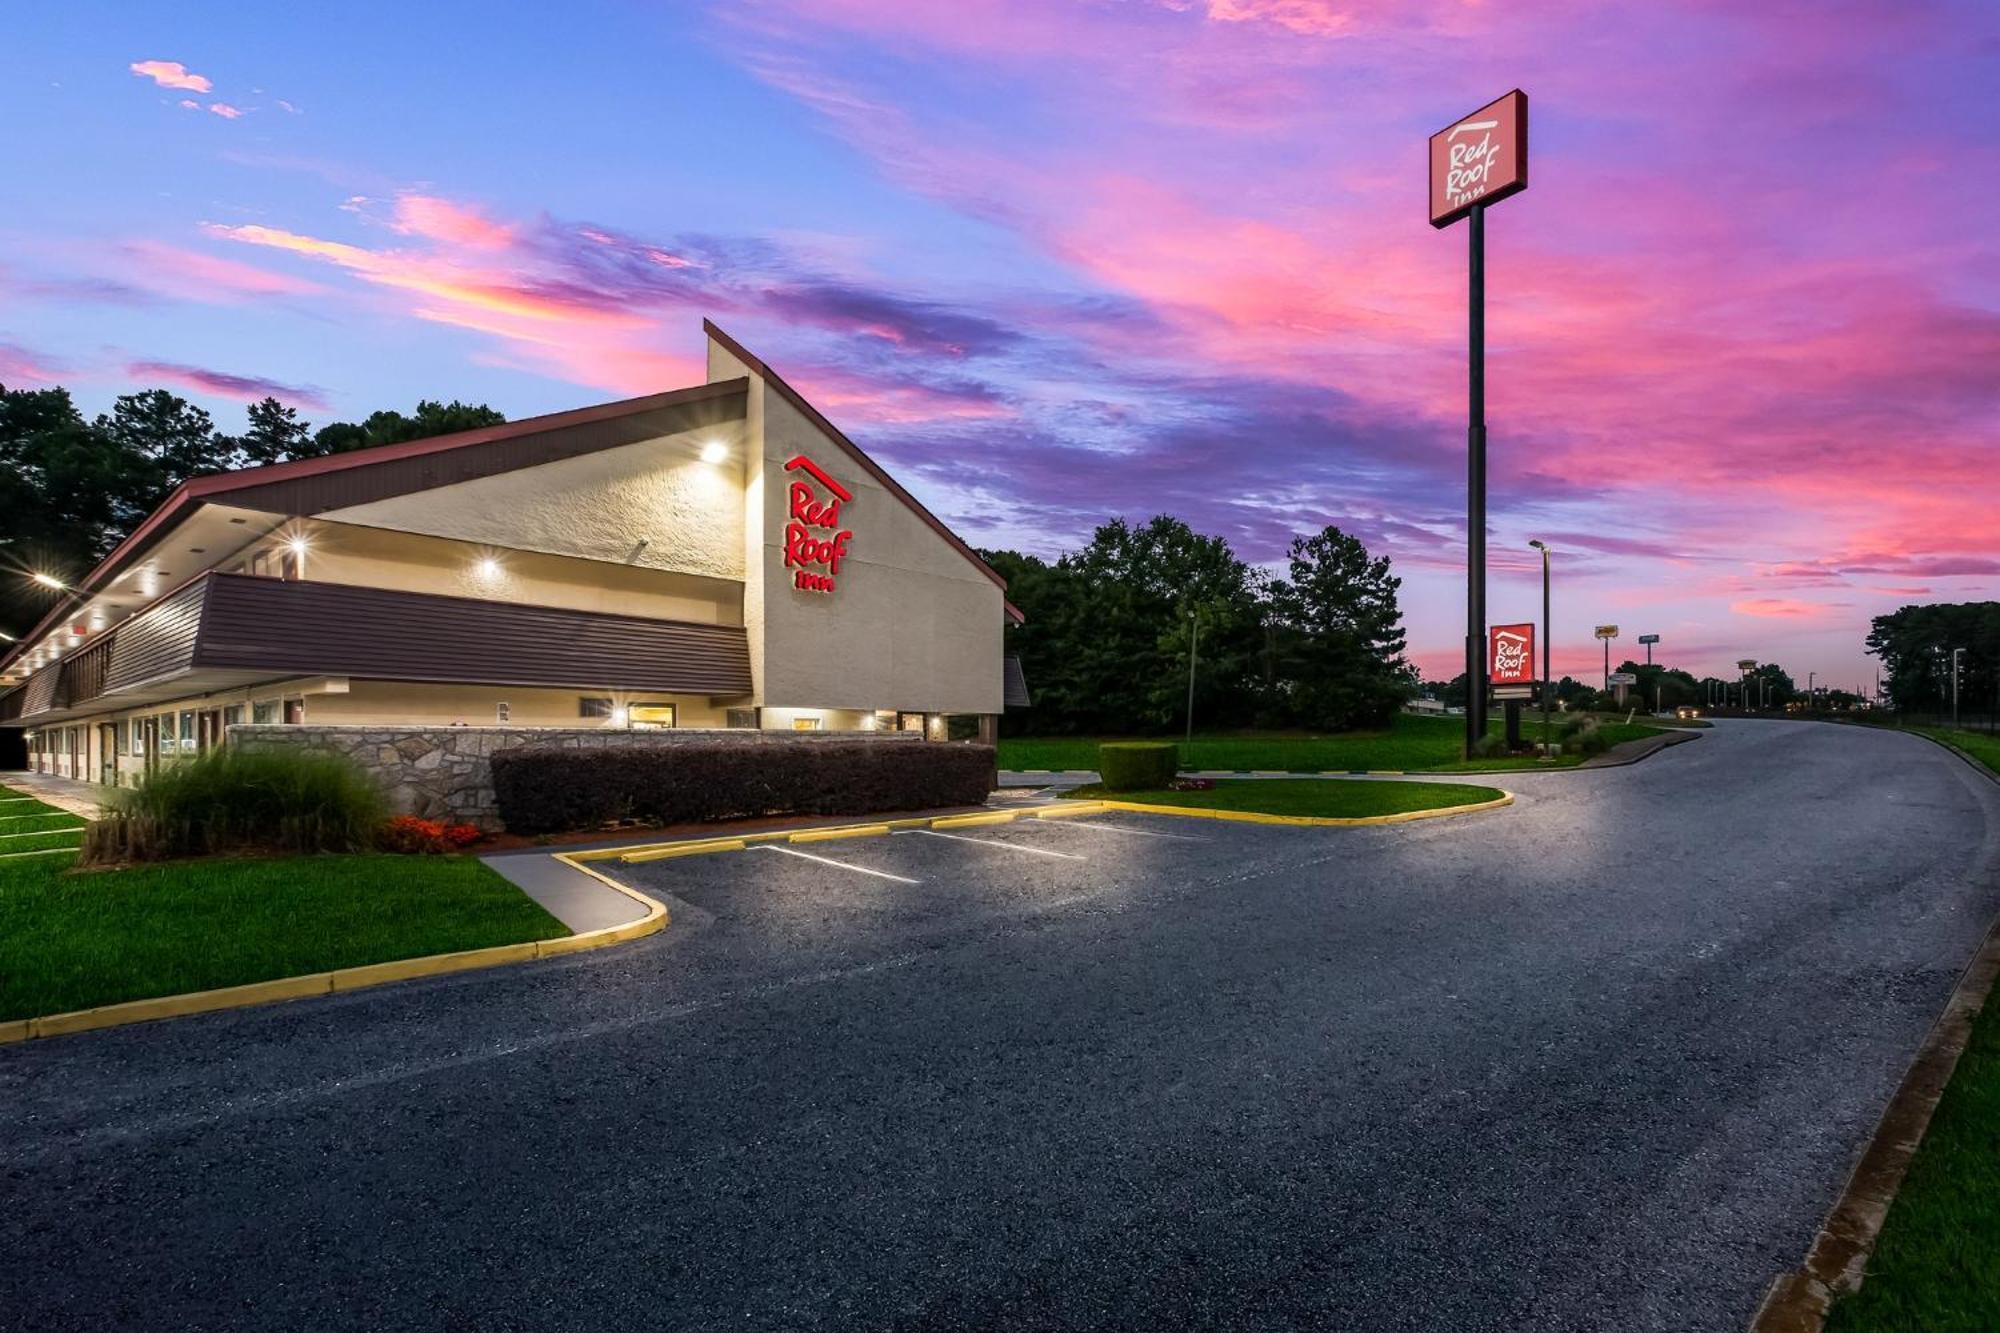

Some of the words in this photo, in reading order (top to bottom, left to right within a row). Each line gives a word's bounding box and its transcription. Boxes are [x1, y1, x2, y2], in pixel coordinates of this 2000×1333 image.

[1446, 145, 1500, 200] Roof
[1450, 132, 1490, 170] Red
[790, 480, 841, 528] Red
[784, 523, 853, 575] Roof
[1494, 652, 1528, 671] Roof
[1496, 640, 1522, 656] Red
